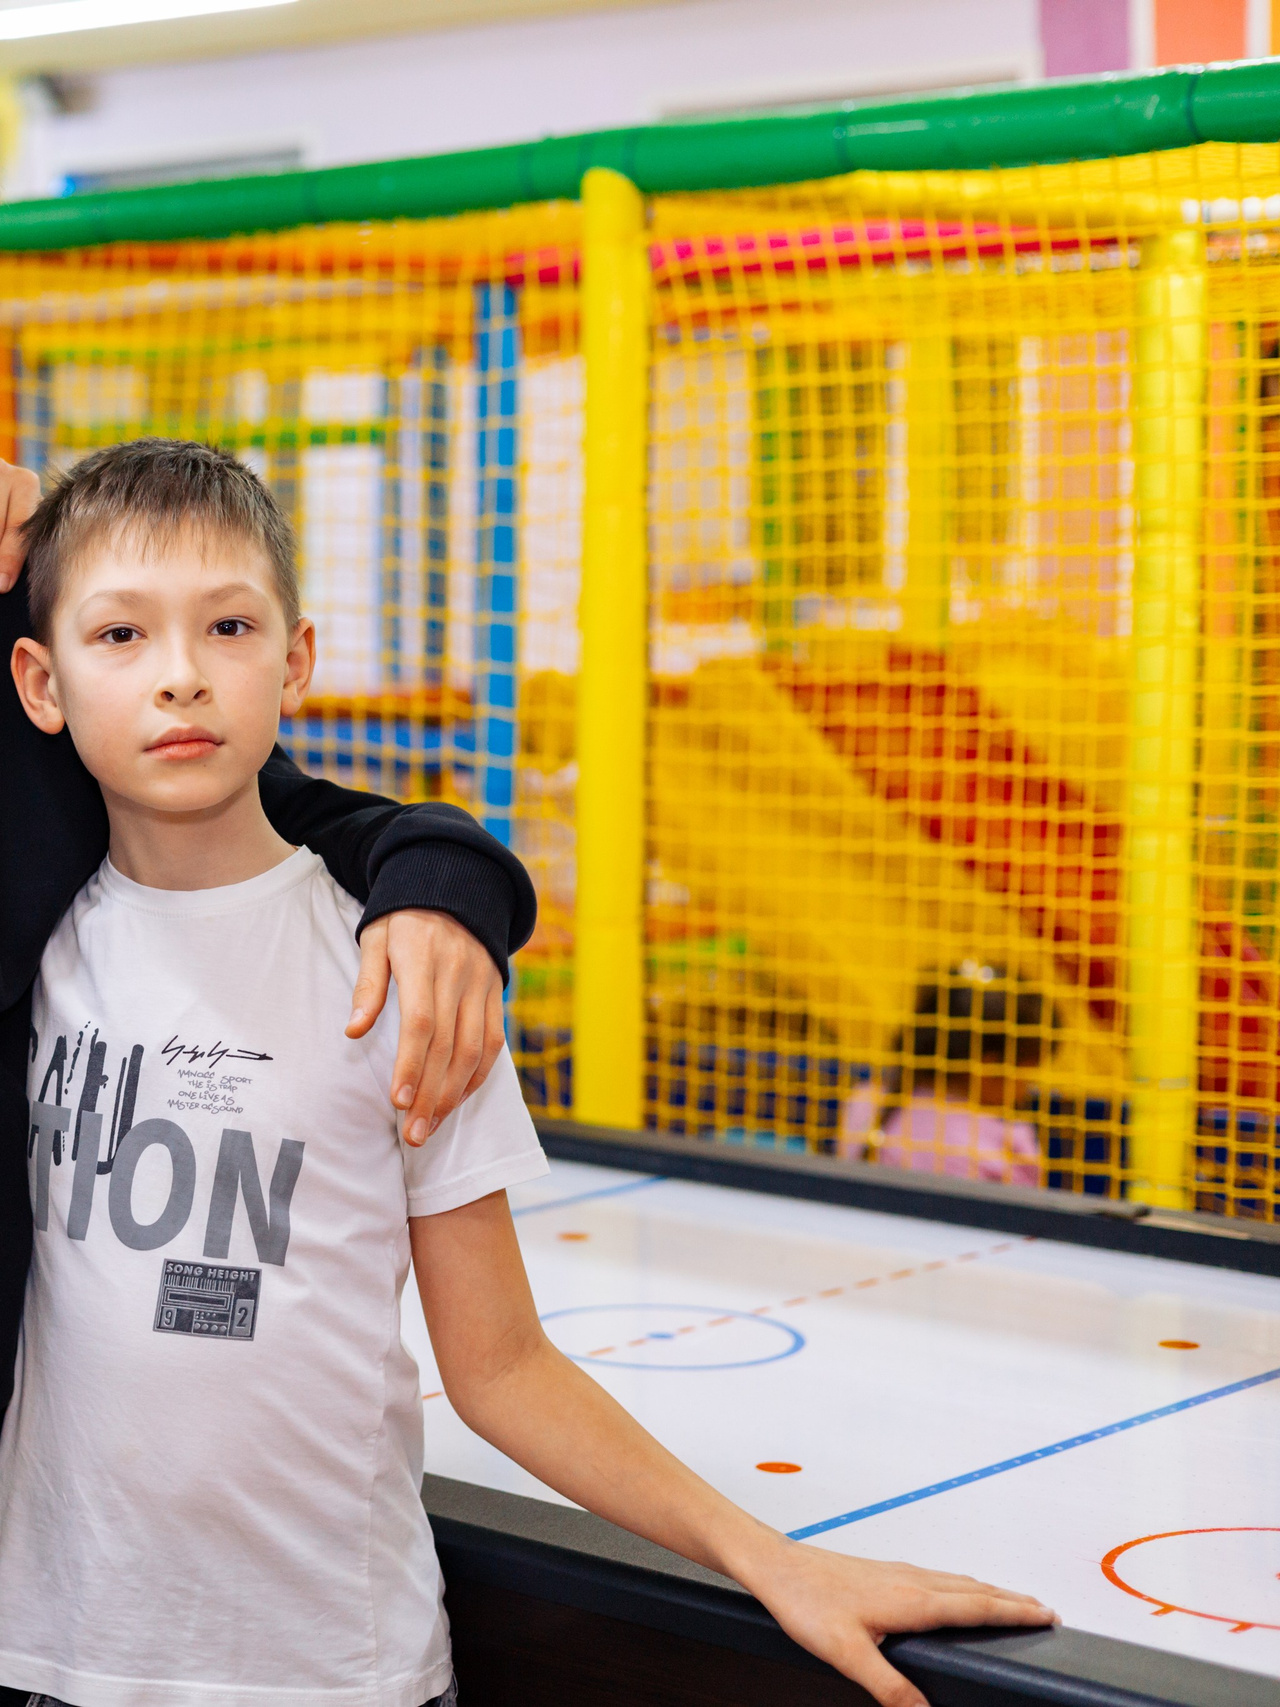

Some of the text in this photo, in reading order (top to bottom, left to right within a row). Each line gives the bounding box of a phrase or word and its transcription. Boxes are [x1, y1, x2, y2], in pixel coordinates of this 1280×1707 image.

[187, 1080, 204, 1089] THE
[220, 1075, 253, 1084] SPORT
[178, 1090, 197, 1100] ONE
[211, 1105, 244, 1114] SOUND
[166, 1263, 256, 1281] SONG HEIGHT
[163, 1309, 173, 1326] 9
[236, 1307, 249, 1328] 2
